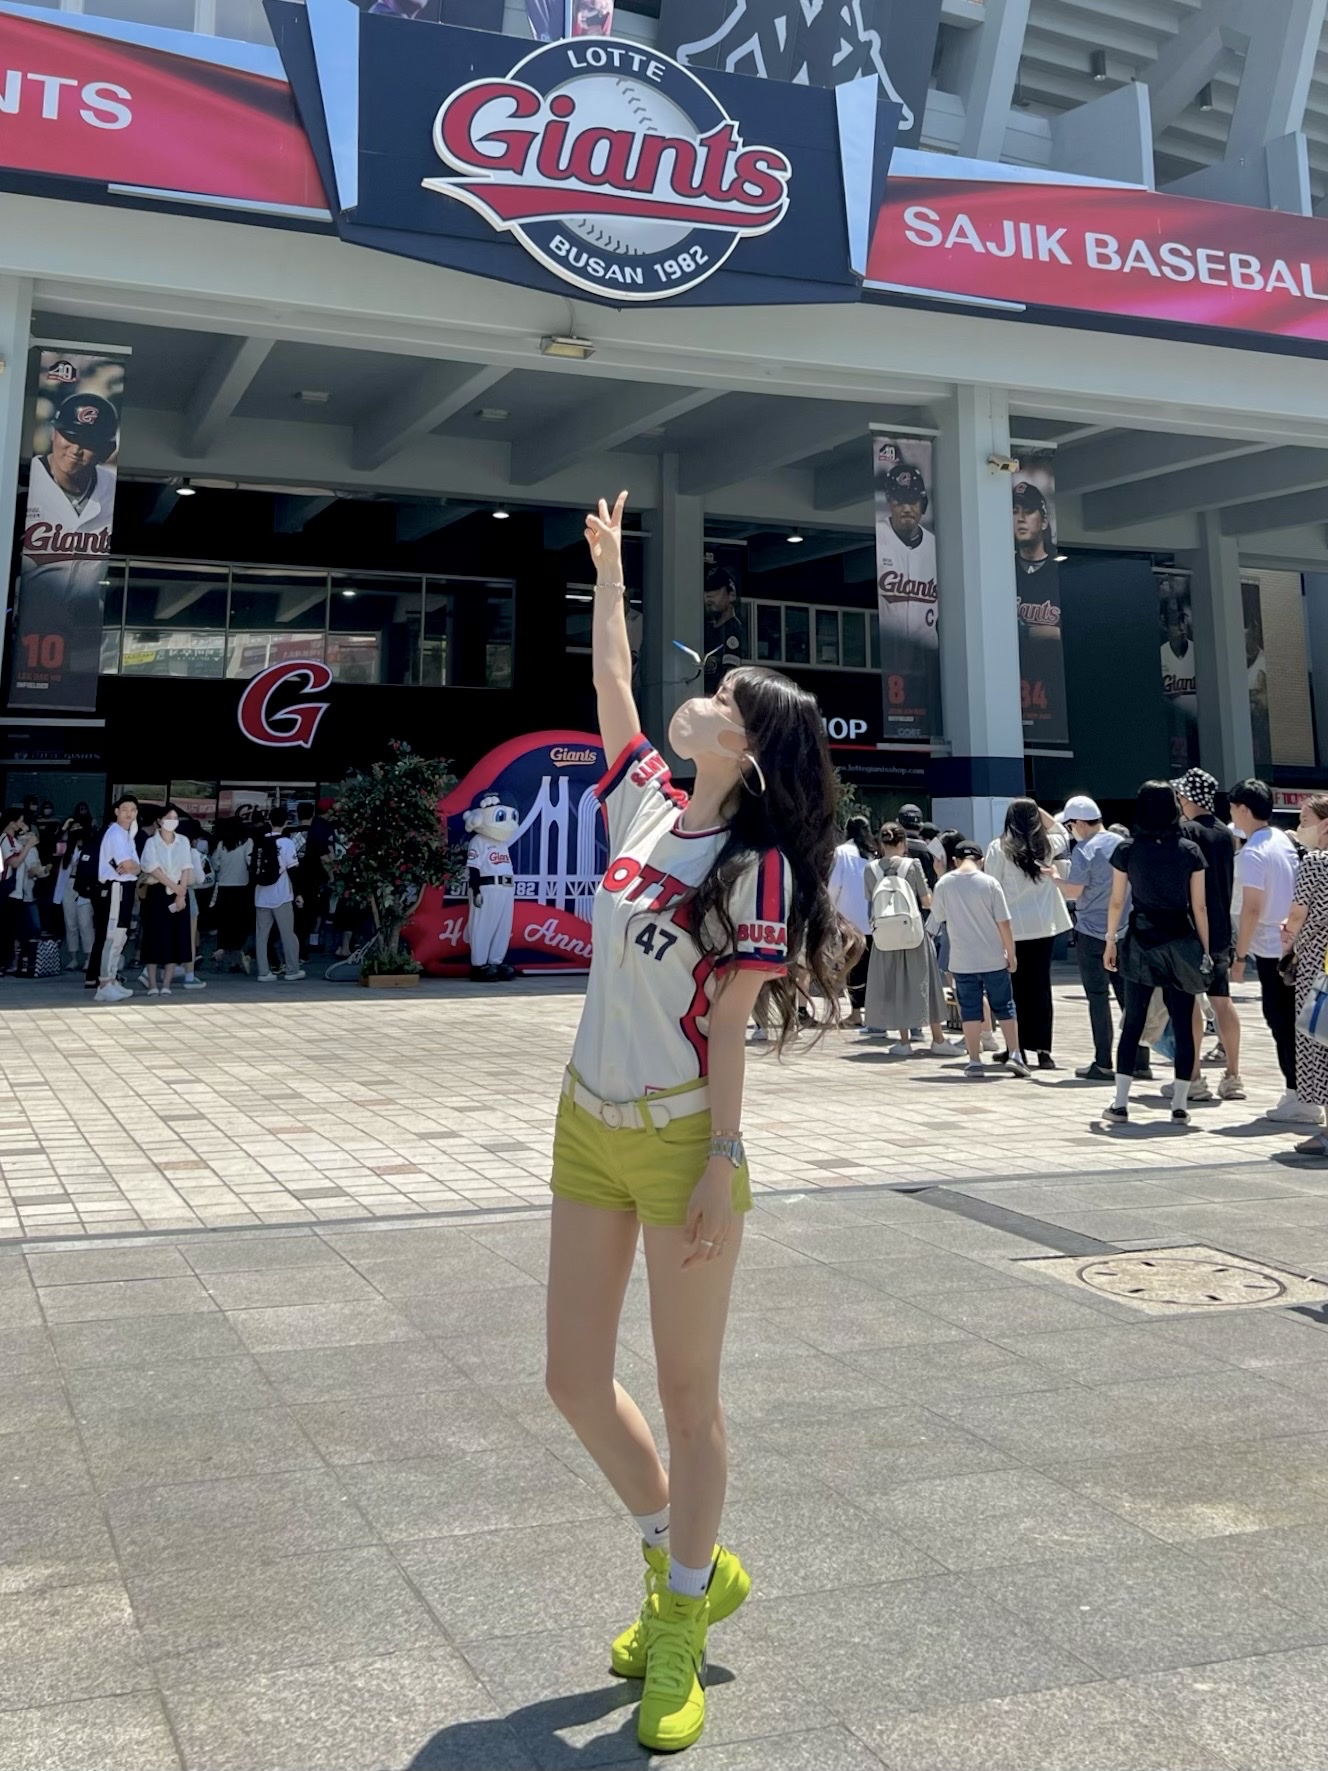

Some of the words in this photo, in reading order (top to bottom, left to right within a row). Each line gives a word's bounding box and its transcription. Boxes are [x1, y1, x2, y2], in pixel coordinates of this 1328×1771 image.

[567, 46, 667, 82] LOTTE
[440, 81, 788, 207] Giants
[903, 205, 1071, 265] SAJIK
[548, 234, 644, 285] BUSAN
[653, 244, 709, 283] 1982
[22, 633, 65, 669] 10
[238, 659, 332, 749] G
[887, 674, 905, 704] 8
[550, 747, 597, 762] Giants
[634, 922, 678, 962] 47
